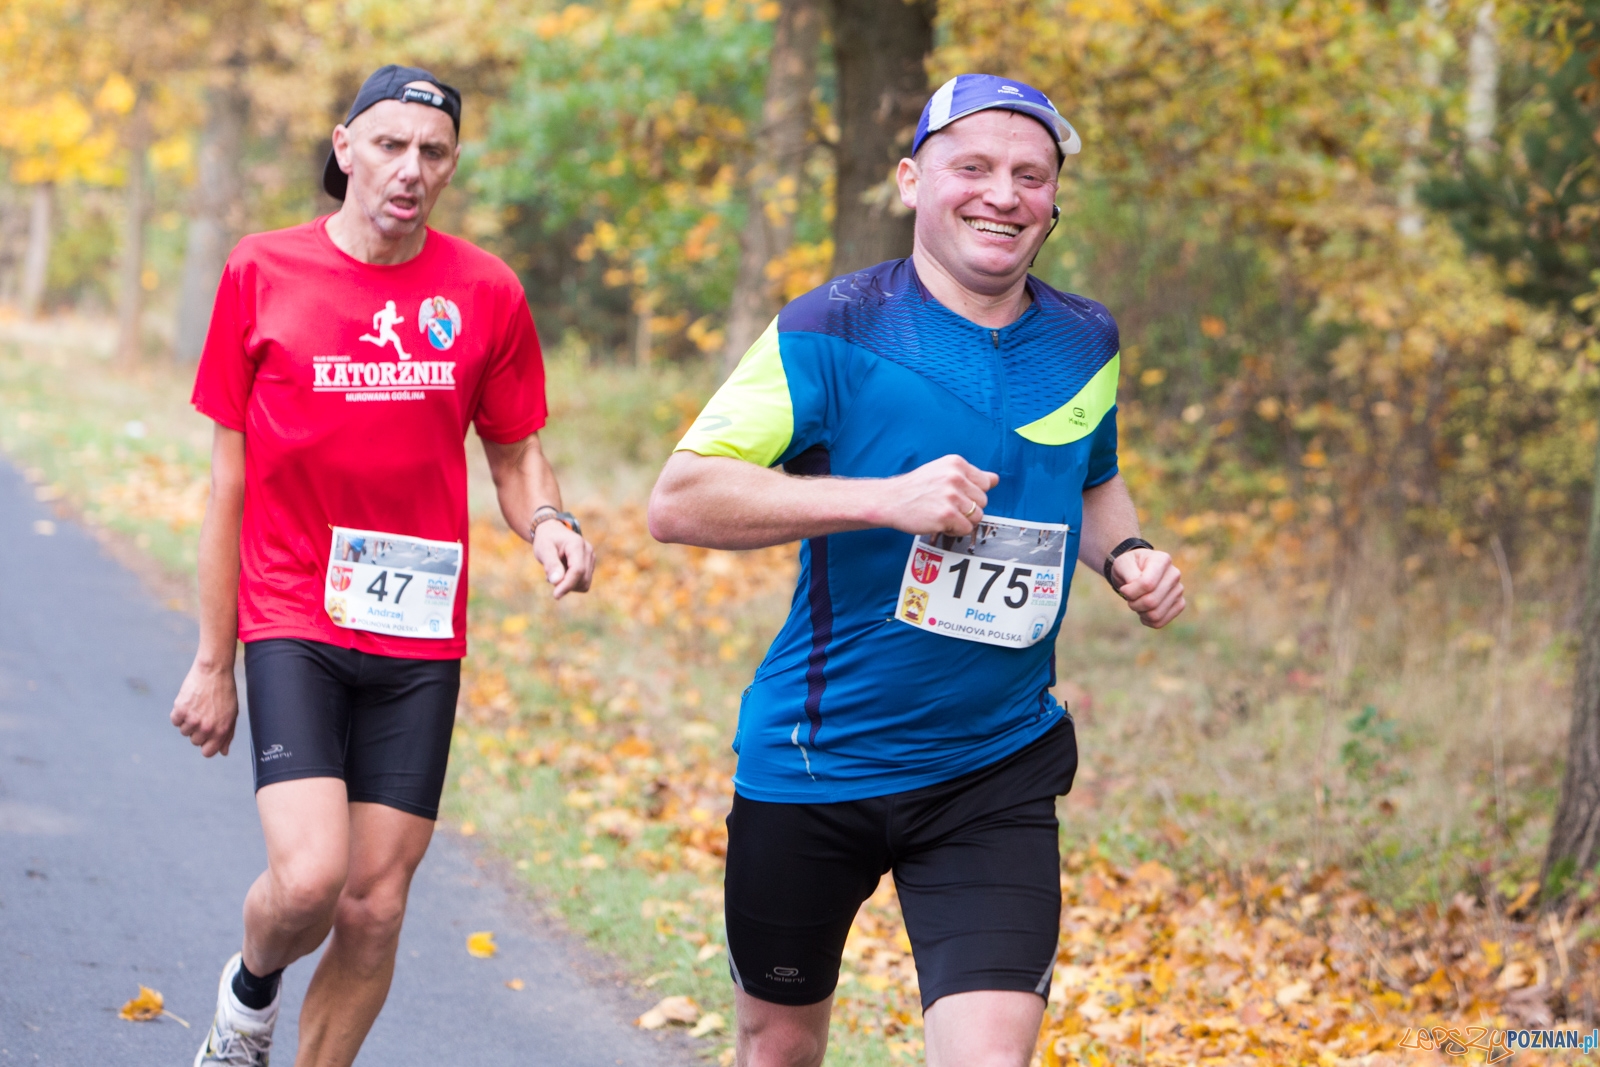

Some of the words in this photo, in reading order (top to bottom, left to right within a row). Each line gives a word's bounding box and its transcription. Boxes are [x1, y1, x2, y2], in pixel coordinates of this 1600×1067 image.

[313, 361, 456, 387] KATORŻNIK
[345, 392, 390, 402] MUROWANA
[391, 390, 425, 400] GOŚLINA
[366, 570, 414, 604] 47
[948, 558, 1033, 609] 175
[367, 606, 404, 622] Andrzej
[964, 608, 996, 623] Piotr
[357, 618, 390, 629] POLINOVA
[393, 623, 419, 632] POLSKA
[937, 620, 985, 637] POLINOVA
[987, 631, 1022, 642] POLSKA
